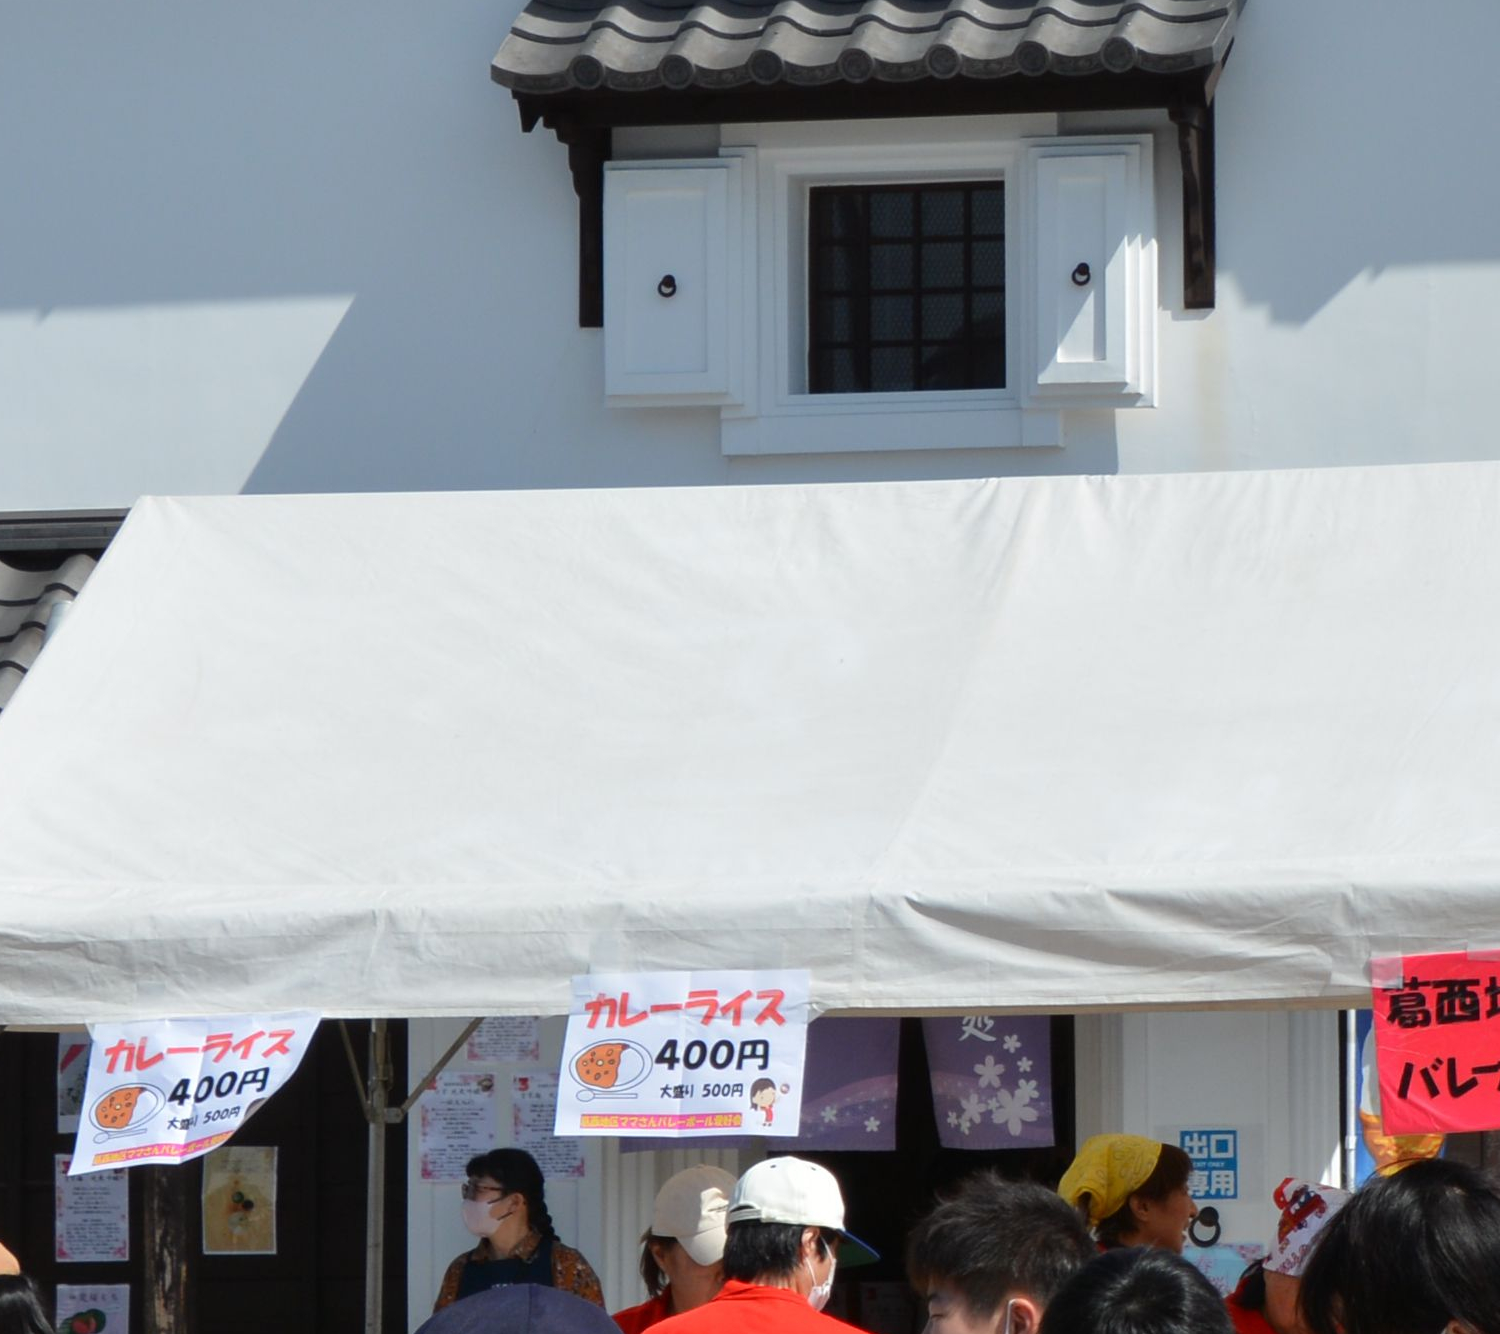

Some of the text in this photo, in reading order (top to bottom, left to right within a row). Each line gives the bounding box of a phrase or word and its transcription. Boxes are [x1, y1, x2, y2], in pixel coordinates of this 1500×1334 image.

[585, 989, 786, 1028] カレーライス
[105, 1029, 295, 1074] カレーライス
[655, 1039, 769, 1070] 400円
[167, 1067, 270, 1106] 400円
[660, 1083, 743, 1099] 大盛り 500円
[203, 1105, 240, 1124] 500円
[1184, 1133, 1234, 1159] 出口
